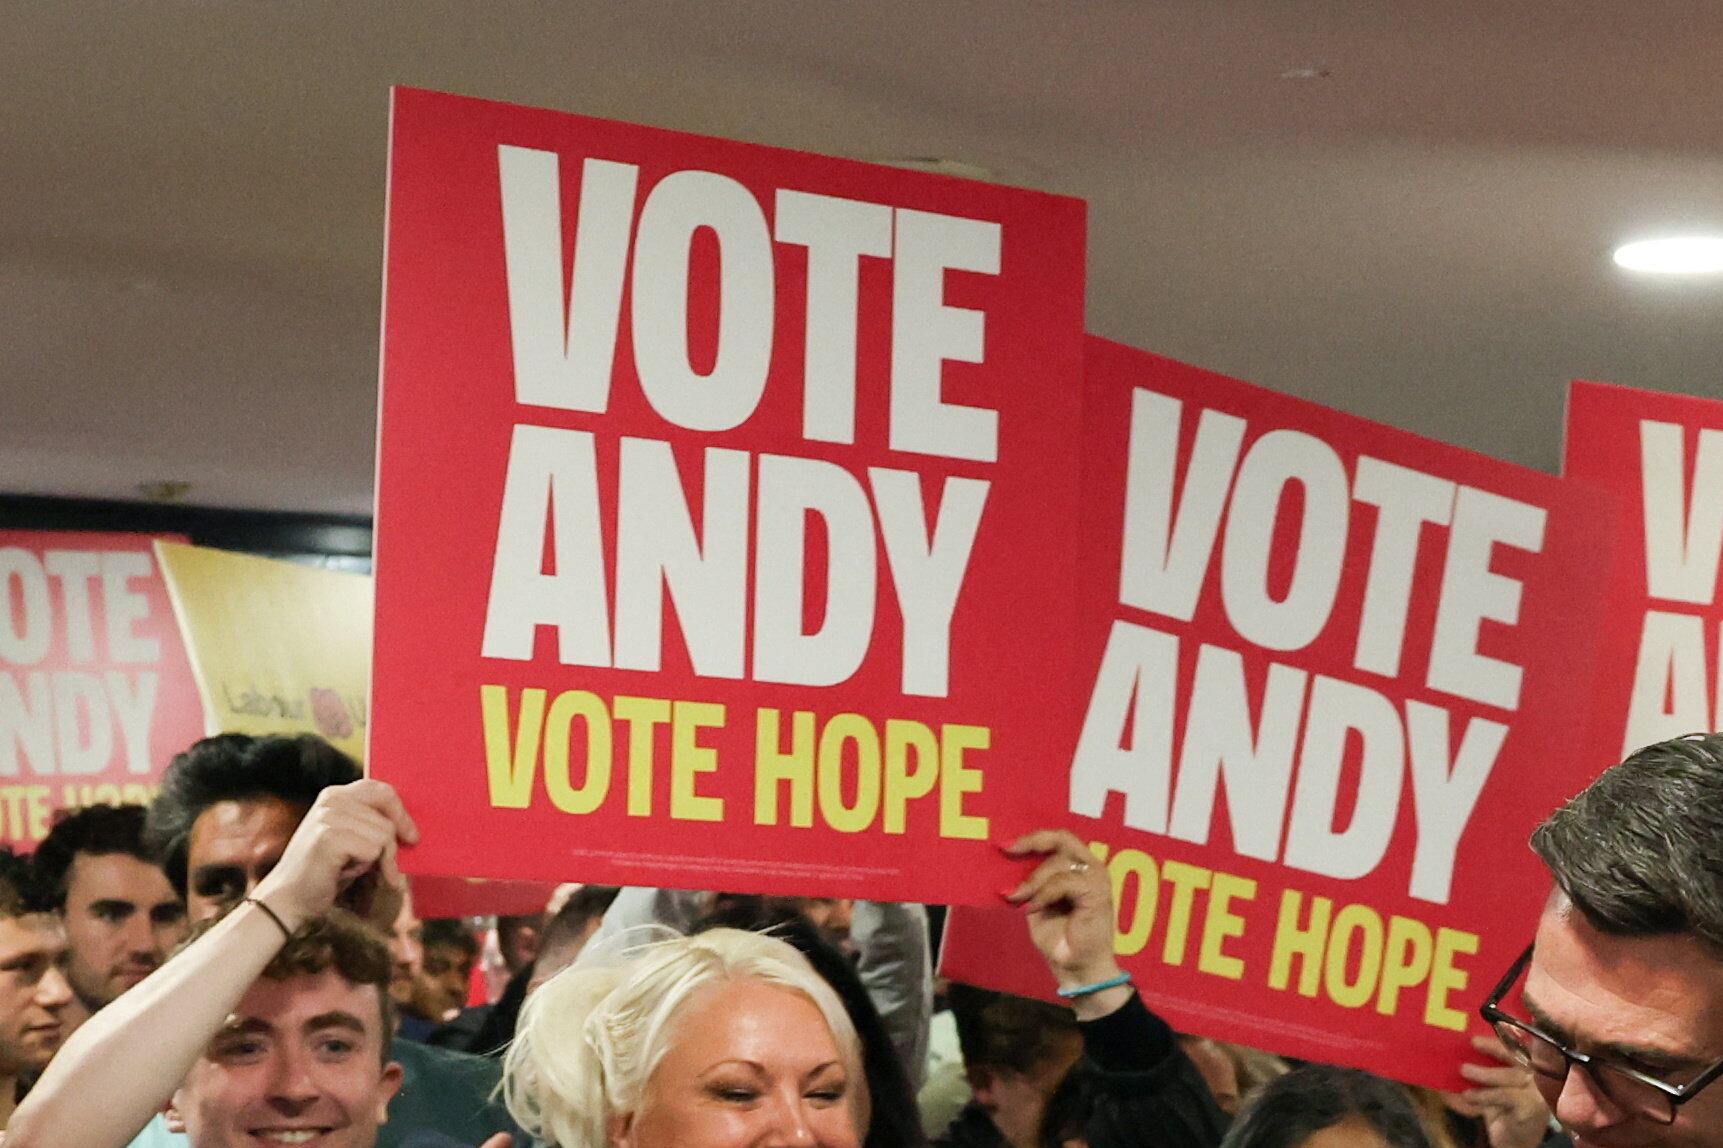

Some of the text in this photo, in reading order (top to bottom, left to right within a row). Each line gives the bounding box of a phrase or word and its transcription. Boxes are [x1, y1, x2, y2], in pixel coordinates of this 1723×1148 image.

[497, 143, 1001, 463] VOTE
[0, 545, 160, 665] OTE
[480, 422, 991, 698] ANDY
[1118, 386, 1548, 712] VOTE
[0, 669, 157, 775] NDY
[480, 685, 991, 840] VOTE HOPE
[1068, 618, 1511, 906] ANDY
[1089, 840, 1258, 980] OTE
[1267, 888, 1480, 1032] HOPE
